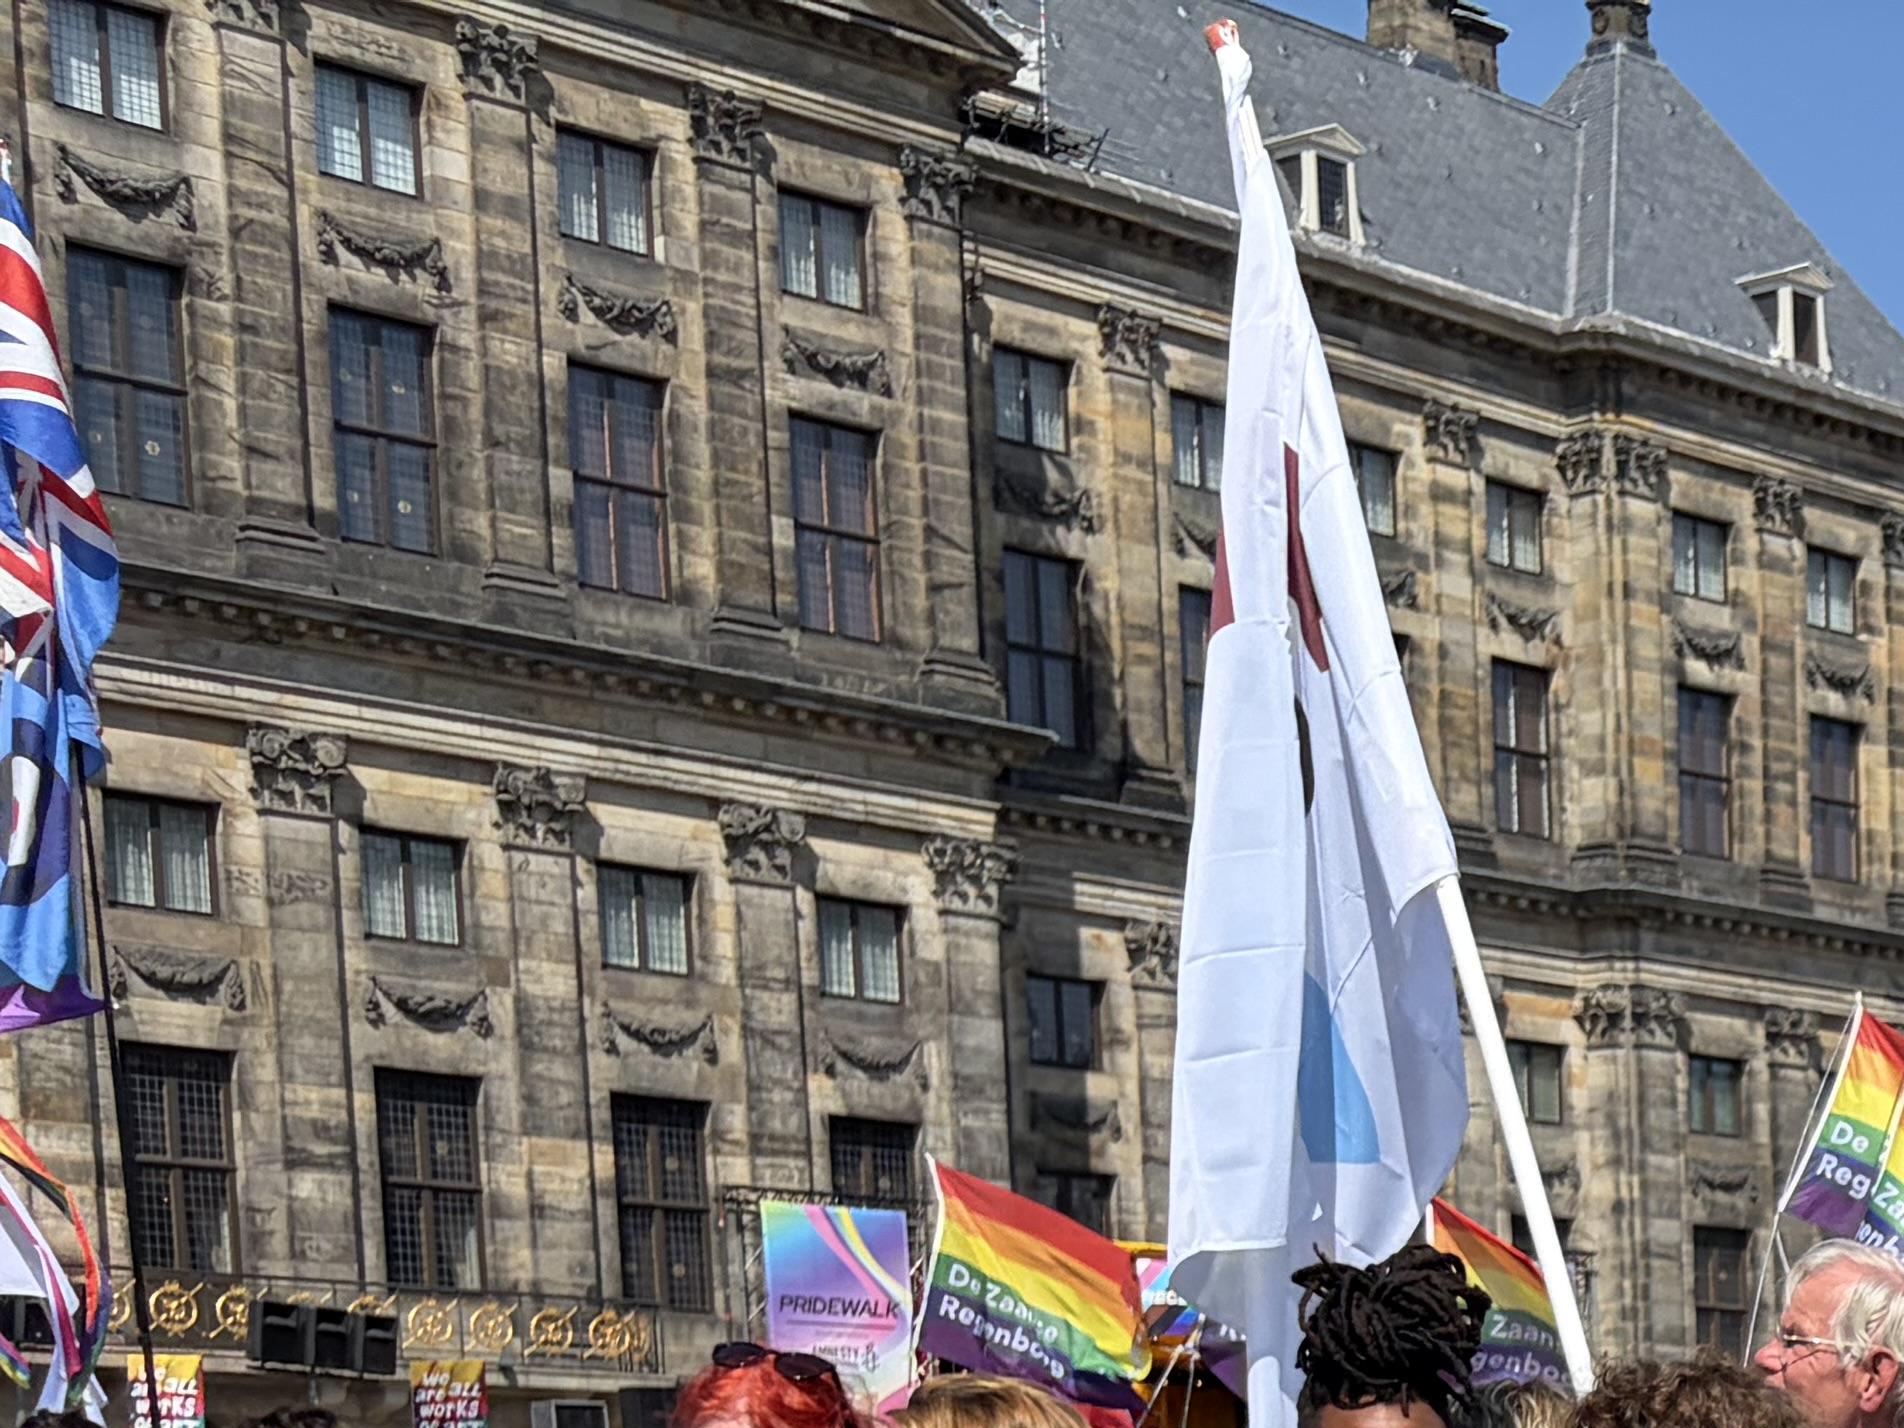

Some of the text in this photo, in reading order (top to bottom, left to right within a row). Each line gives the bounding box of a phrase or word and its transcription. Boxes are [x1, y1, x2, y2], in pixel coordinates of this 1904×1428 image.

[1831, 1120, 1869, 1153] De
[1816, 1153, 1873, 1200] Reg
[779, 1294, 900, 1320] PRIDEWALK
[1490, 1314, 1557, 1350] Zaan
